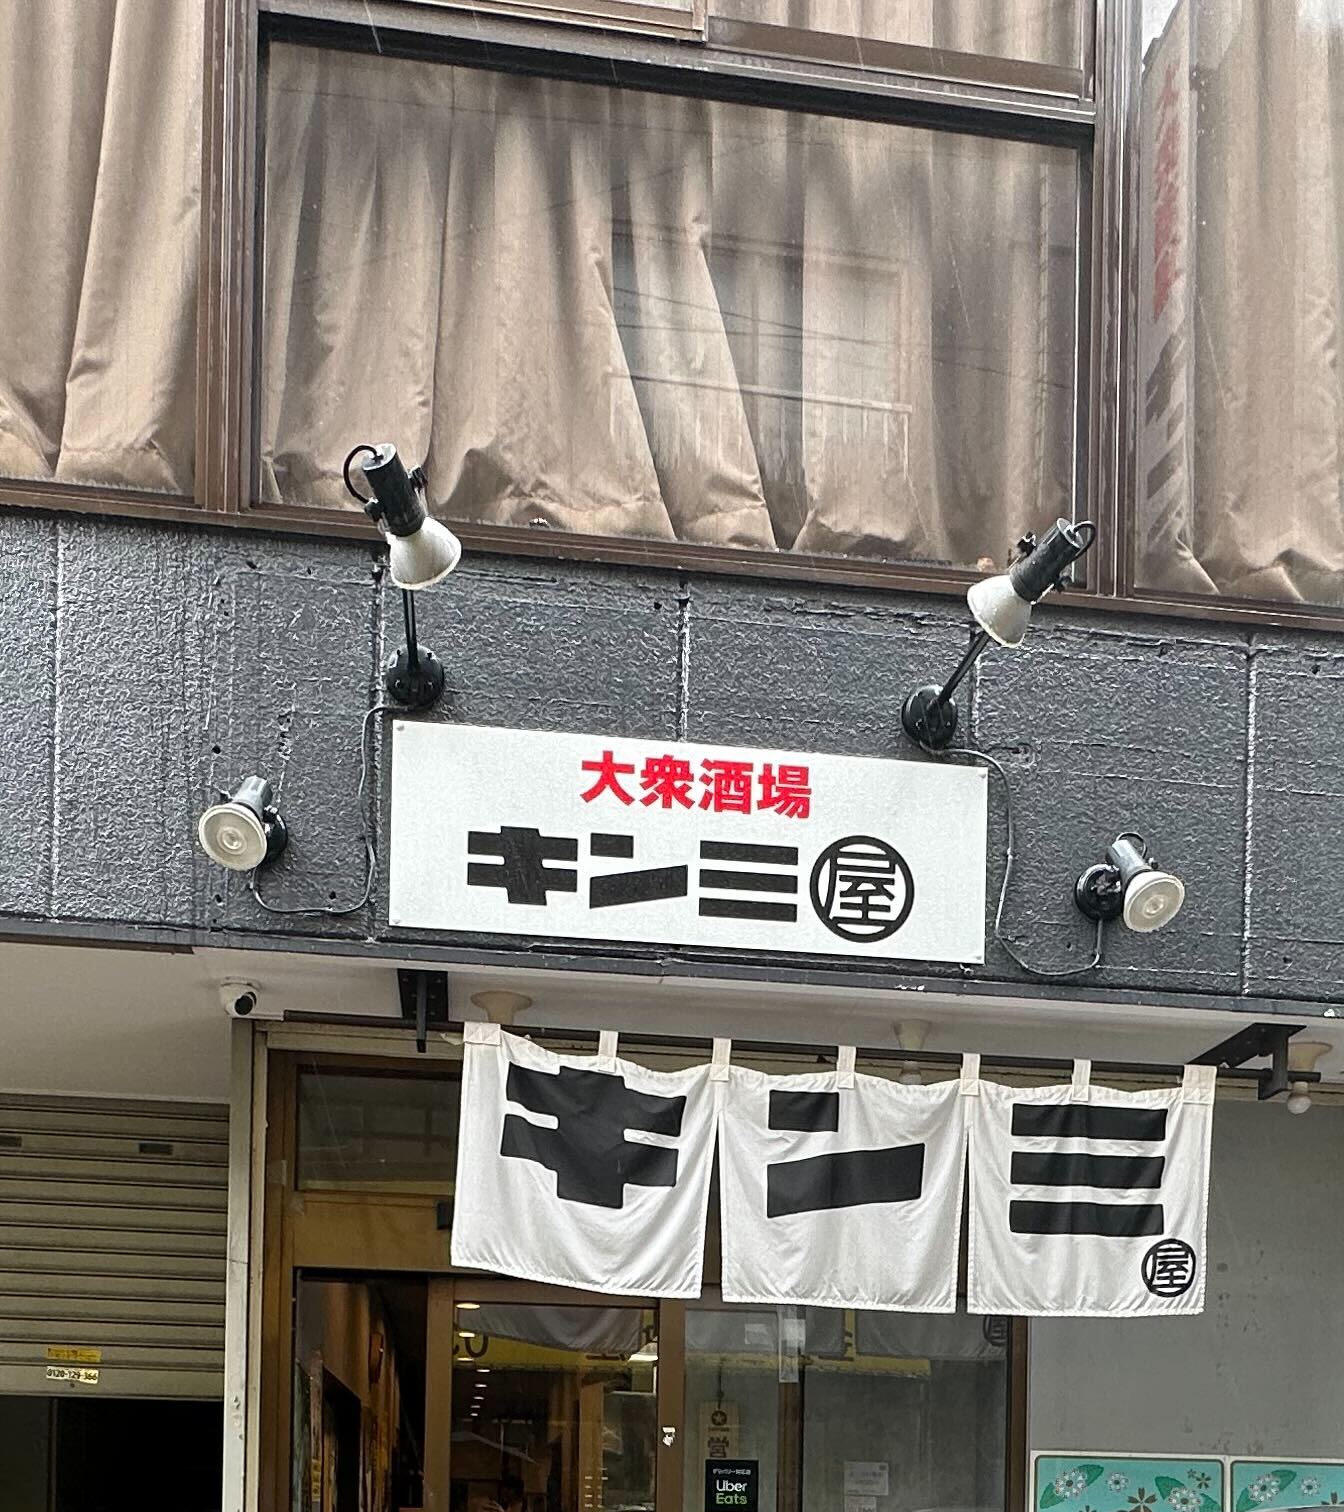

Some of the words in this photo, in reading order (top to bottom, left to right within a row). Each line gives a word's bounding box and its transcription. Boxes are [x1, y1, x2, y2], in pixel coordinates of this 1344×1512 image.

[580, 750, 812, 819] 大衆酒場
[715, 1479, 748, 1492] Uber
[715, 1492, 748, 1505] Eats
